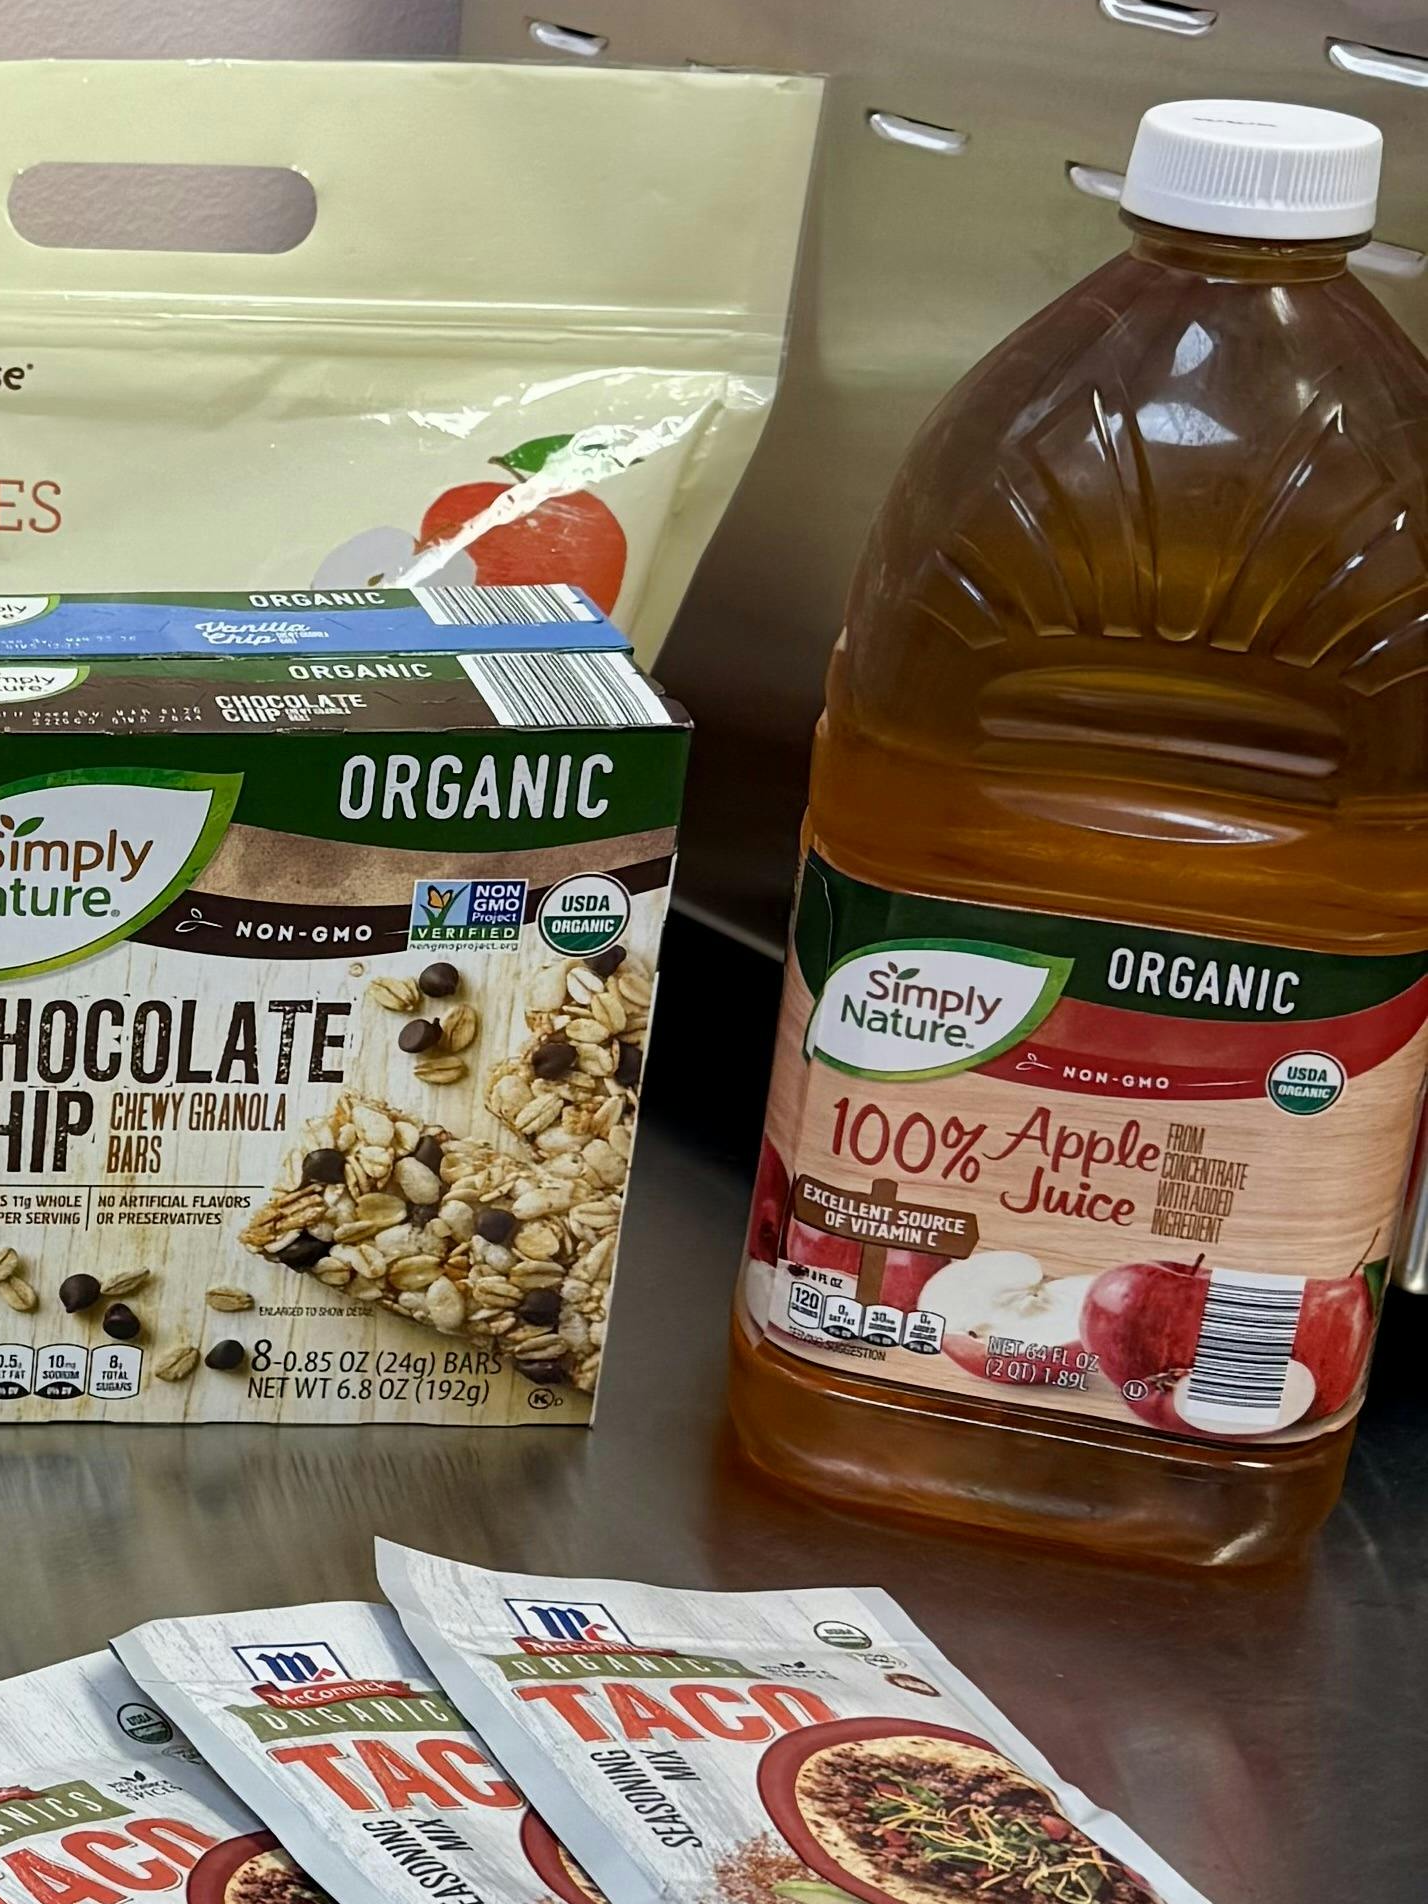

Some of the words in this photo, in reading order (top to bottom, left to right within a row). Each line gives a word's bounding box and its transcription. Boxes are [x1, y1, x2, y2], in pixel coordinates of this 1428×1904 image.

[249, 591, 385, 609] ORGANIC
[288, 663, 431, 681] ORGANIC
[340, 755, 613, 820] ORGANIC
[562, 896, 610, 914] USDA
[236, 921, 372, 944] NON-GMO
[417, 926, 516, 939] VERIFIED
[868, 969, 1002, 1025] Simply
[1108, 947, 1299, 1014] ORGANIC
[1063, 1067, 1170, 1089] NON-GMO
[111, 1093, 183, 1132] CHEWY
[188, 1095, 287, 1132] GRANOLA
[107, 1135, 162, 1174] BARS
[830, 1097, 987, 1184] 100%
[983, 1107, 1160, 1174] Apple
[1000, 1166, 1135, 1226] Juice
[247, 1377, 291, 1398] NET
[296, 1379, 330, 1399] WT
[337, 1379, 371, 1399] 6.8
[379, 1379, 407, 1399] OZ
[415, 1379, 490, 1407] (192g)
[516, 1683, 831, 1743] TACO
